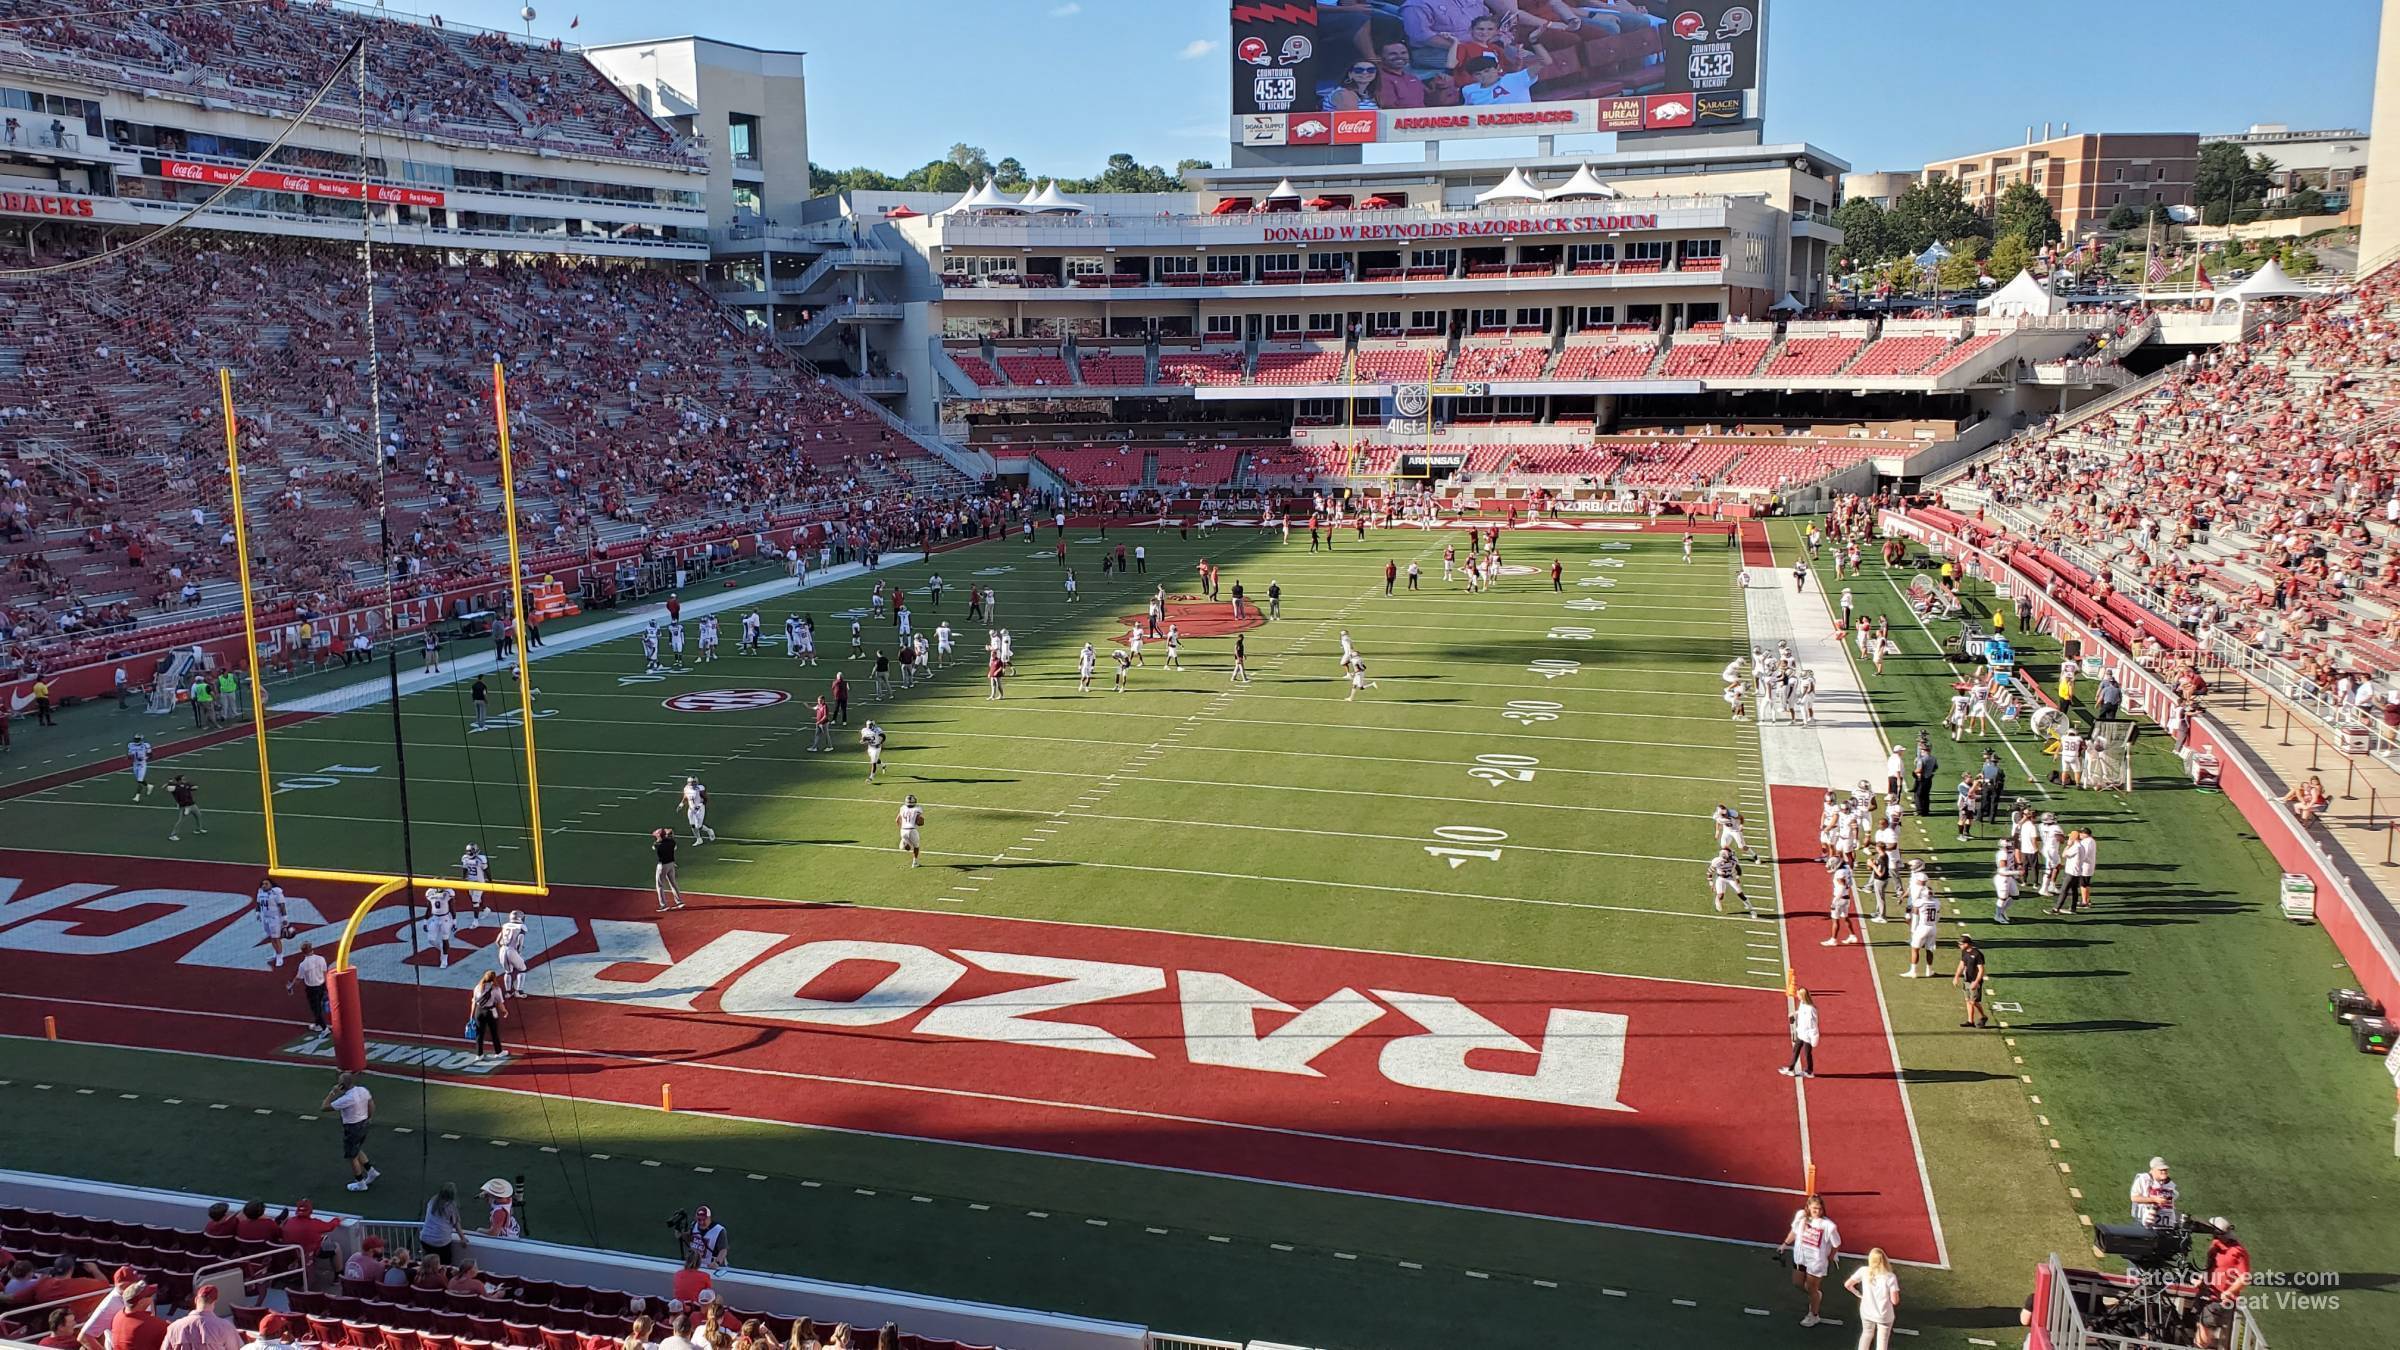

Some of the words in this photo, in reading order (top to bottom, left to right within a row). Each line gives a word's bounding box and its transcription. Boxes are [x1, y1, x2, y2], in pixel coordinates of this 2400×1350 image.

[1691, 43, 1731, 53] COUNTDOWN
[1256, 69, 1293, 78] COUNTDOWN
[1690, 54, 1732, 78] 45:32
[1255, 79, 1294, 100] 45:32
[1692, 80, 1701, 89] TO
[1702, 79, 1728, 88] KICKOFF
[1258, 102, 1267, 111] TO
[1267, 101, 1291, 111] KICKOFF
[1612, 101, 1639, 110] FARM
[1394, 115, 1469, 130] ARKANSAS
[1477, 110, 1574, 126] RAZORBACKS
[1602, 109, 1639, 120] BUREAU
[213, 170, 229, 180] Real
[1263, 227, 1335, 242] DONALD
[1339, 225, 1355, 240] W
[1359, 222, 1453, 239] REYNOLDS
[1457, 217, 1570, 235] RAZORBACK
[1573, 213, 1659, 231] STADIUM
[1385, 418, 1443, 435] Allstae
[1408, 456, 1460, 465] ARKANSAS
[1526, 659, 1582, 676] 40
[1501, 700, 1564, 721] 30
[1467, 754, 1540, 782] 20
[1423, 826, 1509, 861] 10
